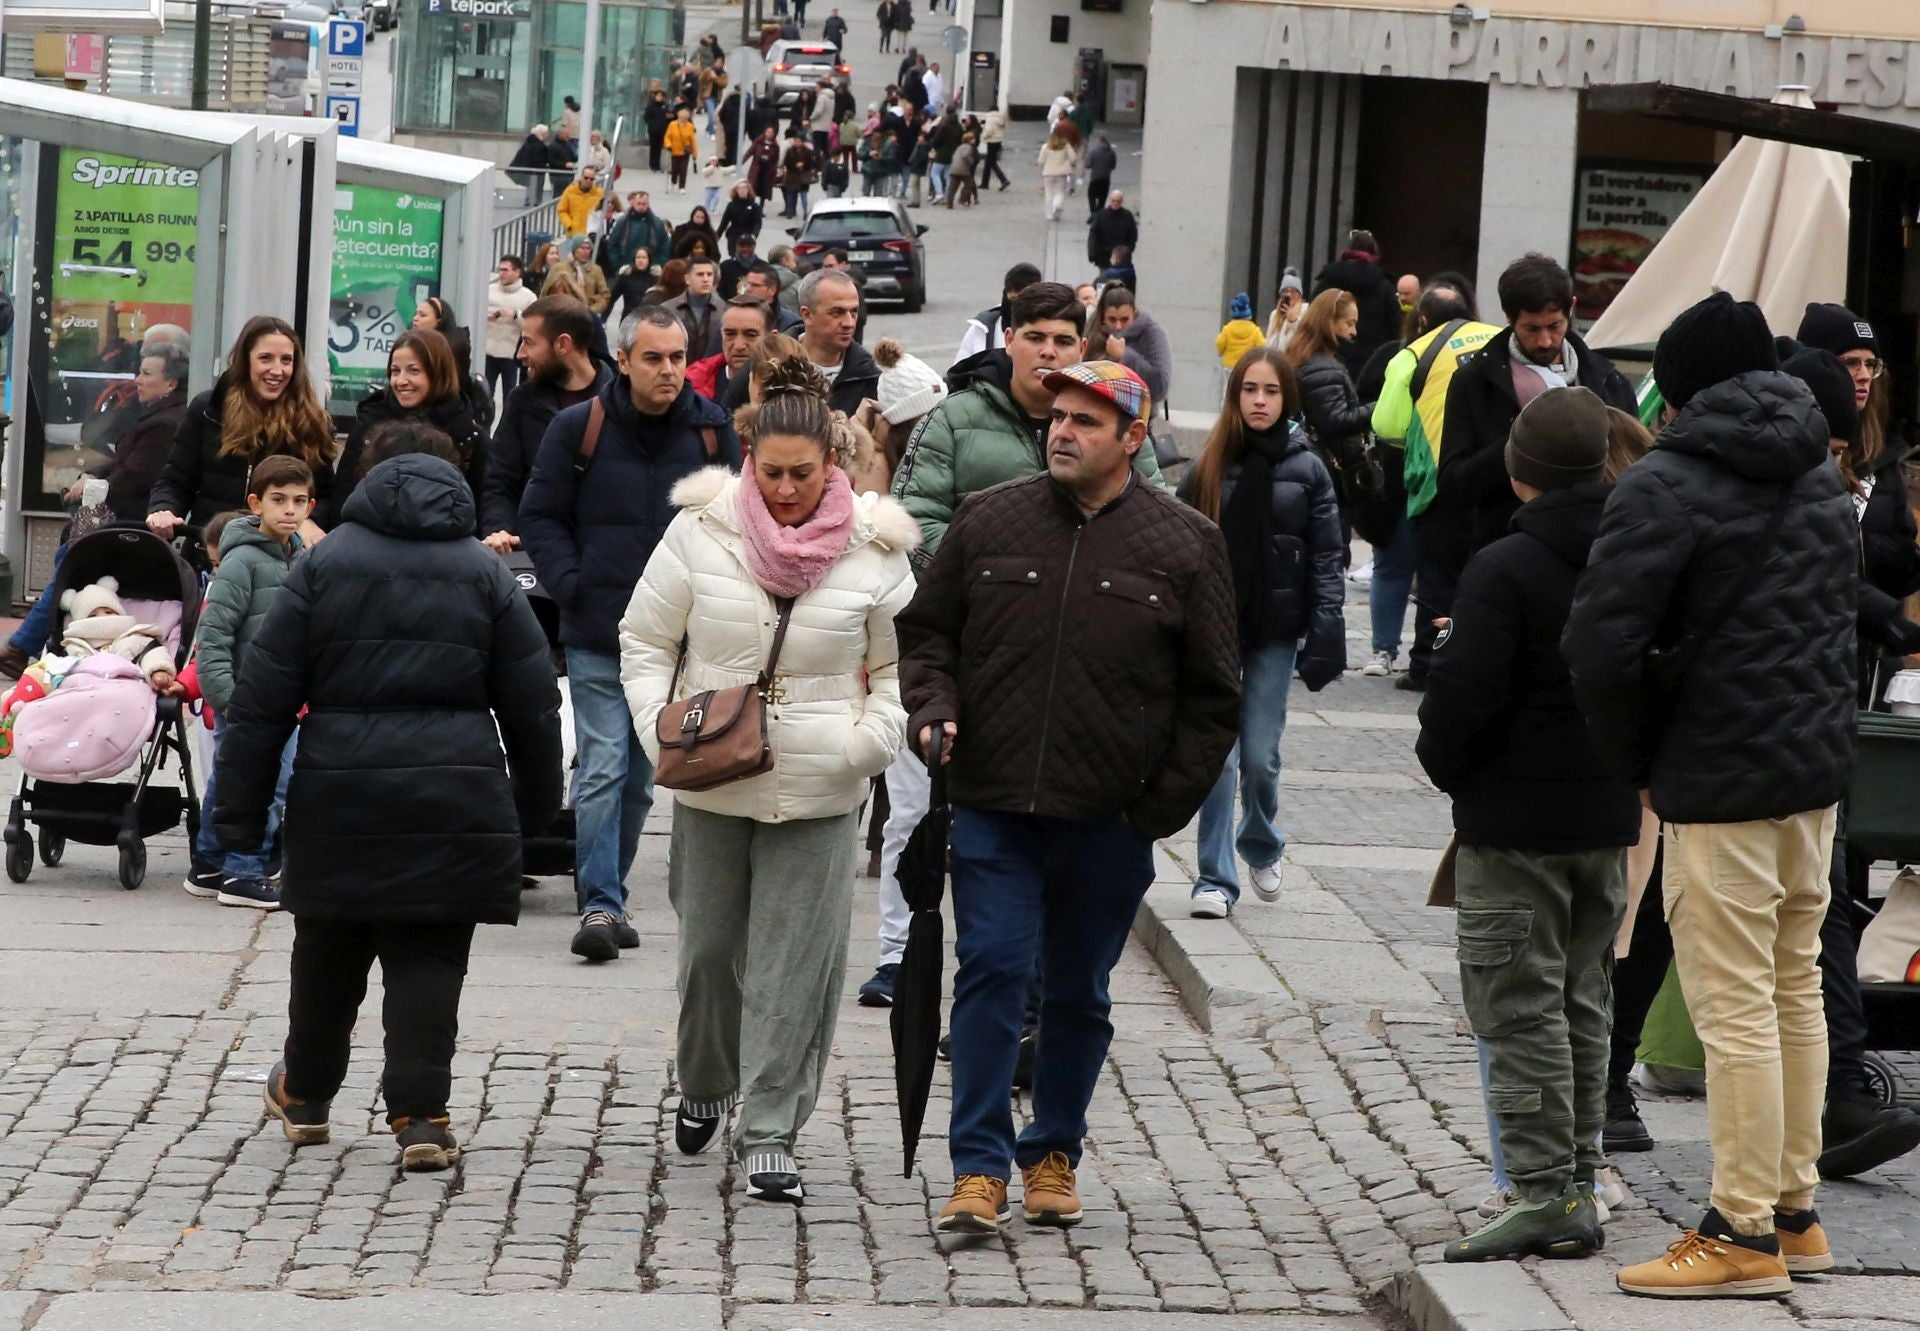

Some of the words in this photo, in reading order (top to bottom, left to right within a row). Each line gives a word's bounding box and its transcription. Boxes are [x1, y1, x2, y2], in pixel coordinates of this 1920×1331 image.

[451, 0, 514, 16] telpark
[335, 24, 358, 52] P
[1263, 6, 1306, 70] A
[1330, 8, 1408, 77] LA
[1431, 13, 1753, 98] PARRILLA
[330, 62, 359, 72] HOTEL
[72, 156, 199, 189] Sprinte
[1588, 173, 1605, 188] El
[1606, 176, 1692, 193] verdadero
[1588, 192, 1632, 206] sabor
[1636, 196, 1647, 208] a
[74, 210, 154, 224] ZAPATILLAS
[368, 217, 394, 235] sin
[398, 219, 414, 236] la
[1586, 208, 1603, 222] la
[1604, 209, 1668, 227] parrilla
[1465, 332, 1497, 344] ONC
